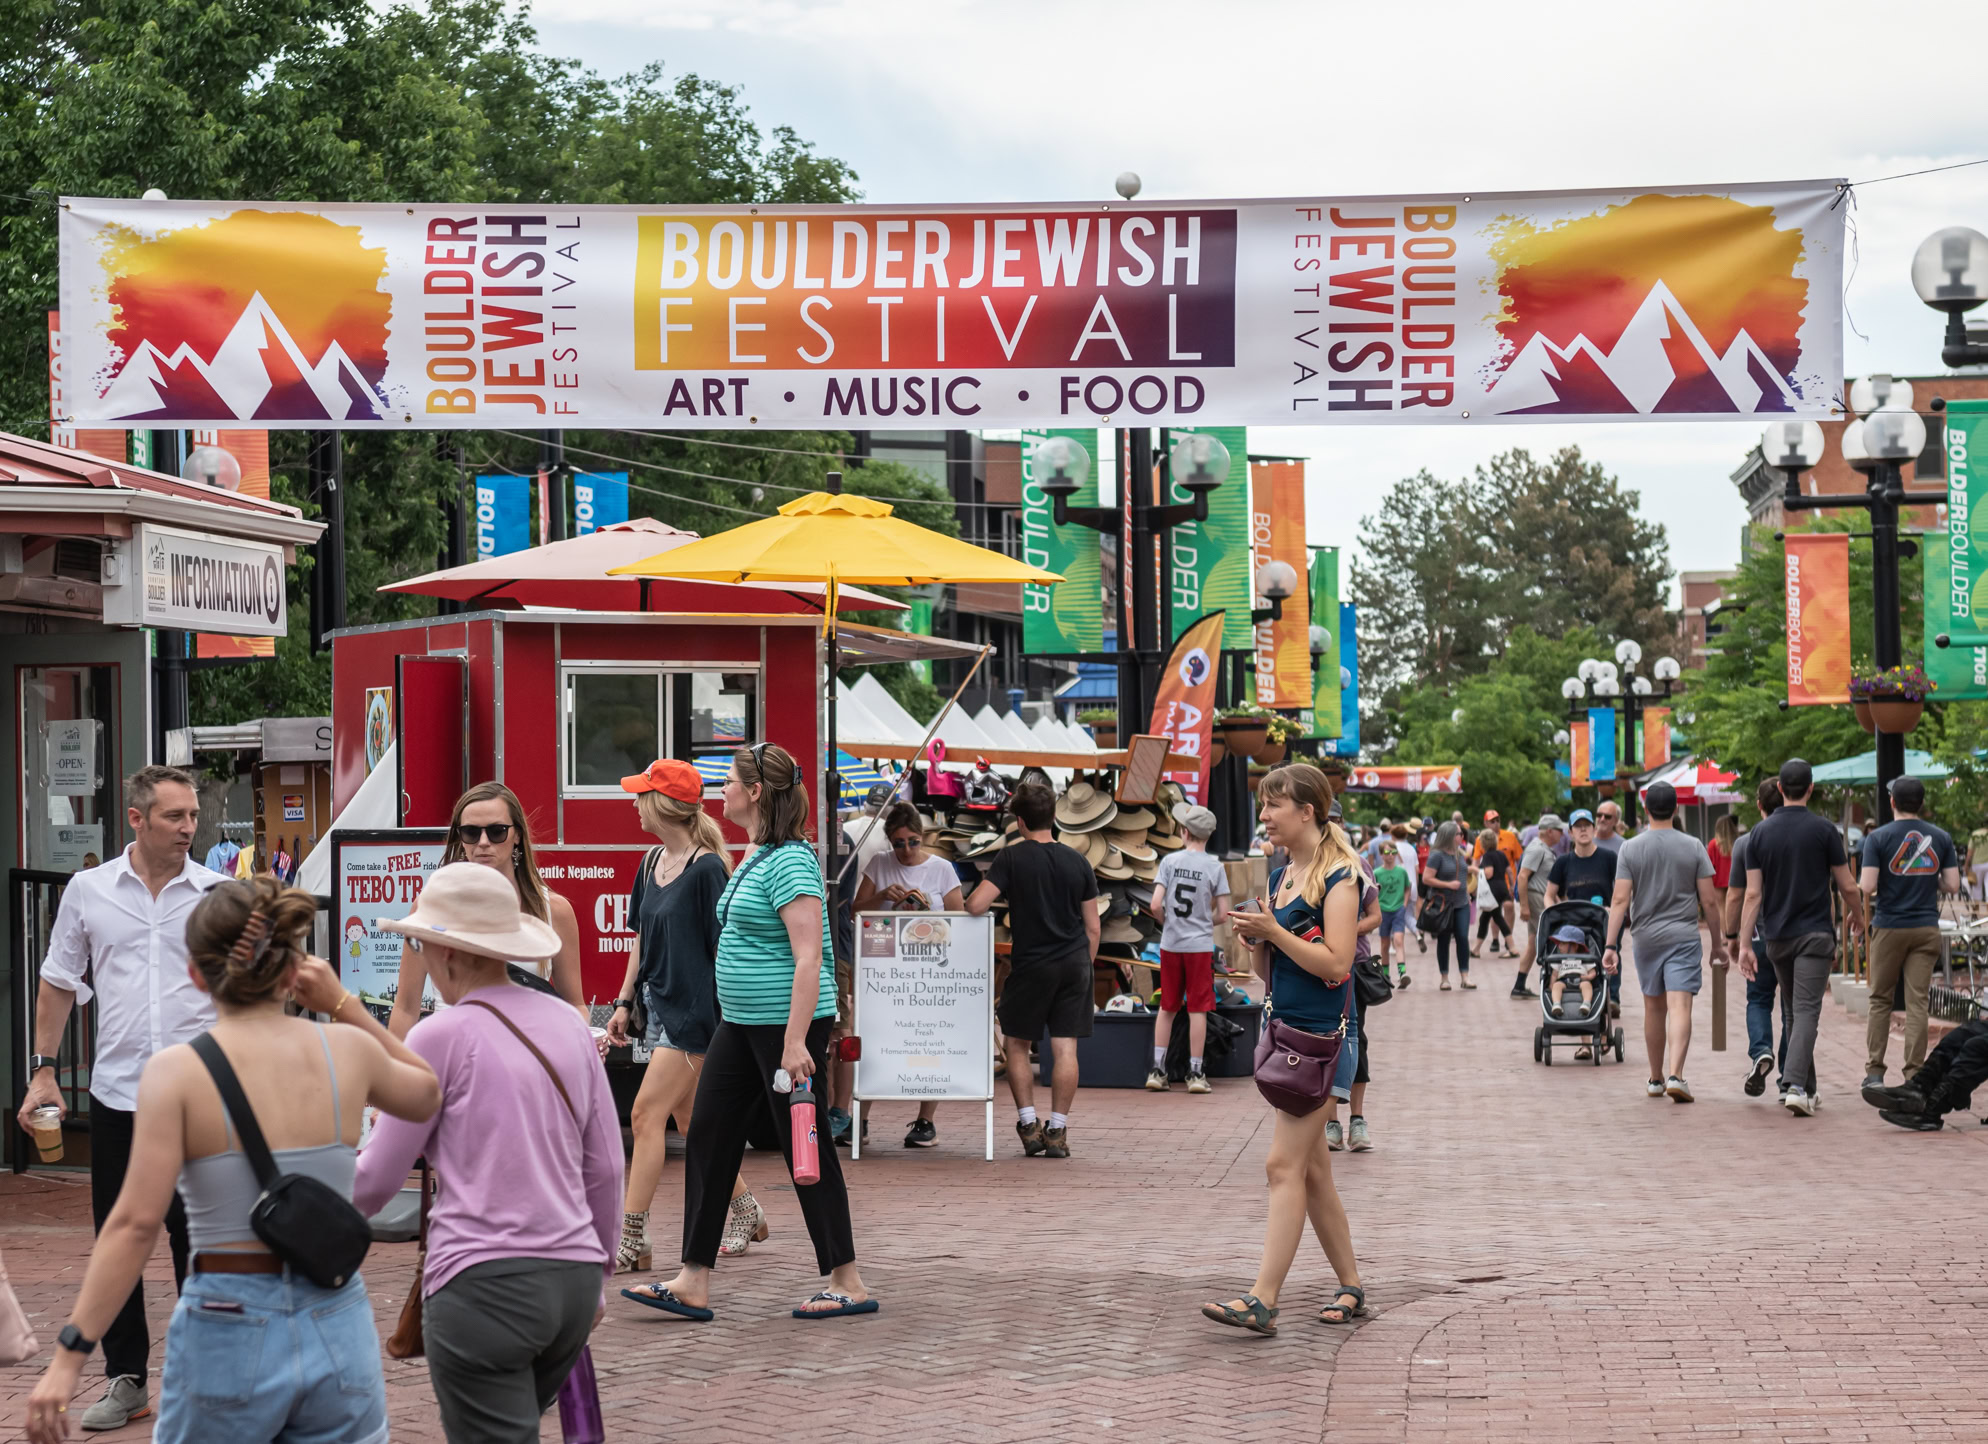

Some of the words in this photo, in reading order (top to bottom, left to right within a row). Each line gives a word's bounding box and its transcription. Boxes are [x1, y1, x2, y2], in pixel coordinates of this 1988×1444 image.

[660, 219, 953, 290] BOULDER
[959, 216, 1202, 288] JEWISH
[424, 216, 478, 414] BOULDER
[1293, 208, 1322, 411] FESTIVAL
[1328, 207, 1395, 412] JEWISH
[1401, 205, 1457, 410] BOULDER
[481, 216, 547, 415] JEWISH
[551, 216, 581, 415] FESTIVAL
[660, 294, 1203, 364] FESTIVAL
[662, 378, 750, 416] ART
[823, 376, 982, 416] MUSIC
[1060, 375, 1205, 415] FOOD
[171, 553, 262, 615] INFORMATION
[286, 809, 303, 817] VISA
[347, 863, 365, 871] Come
[366, 862, 381, 871] take
[388, 852, 421, 873] FREE
[423, 862, 437, 871] ride
[567, 865, 615, 880] Nepalese
[1174, 868, 1203, 881] MIELKE
[347, 875, 395, 904] TEBO
[399, 875, 424, 904] TR
[1174, 883, 1197, 919] 5
[370, 931, 384, 939] MAY
[375, 944, 387, 952] 9:30
[388, 944, 398, 952] AM
[862, 967, 886, 979] The
[890, 967, 916, 979] Best
[921, 968, 988, 980] Handmade
[866, 981, 910, 995] Nepali
[914, 981, 984, 996] Dumplings
[893, 994, 904, 1006] in
[909, 994, 957, 1006] Boulder
[894, 1020, 916, 1028] Made
[917, 1020, 938, 1029] Every
[939, 1020, 955, 1029] Day
[914, 1028, 935, 1036] Fresh
[903, 1039, 927, 1047] Served
[928, 1039, 945, 1047] with
[880, 1047, 921, 1055] Homemade
[923, 1047, 946, 1056] Vegan
[946, 1047, 968, 1055] Sauce
[897, 1073, 912, 1083] No
[914, 1073, 951, 1083] Artificial
[901, 1085, 947, 1096] Ingredients
